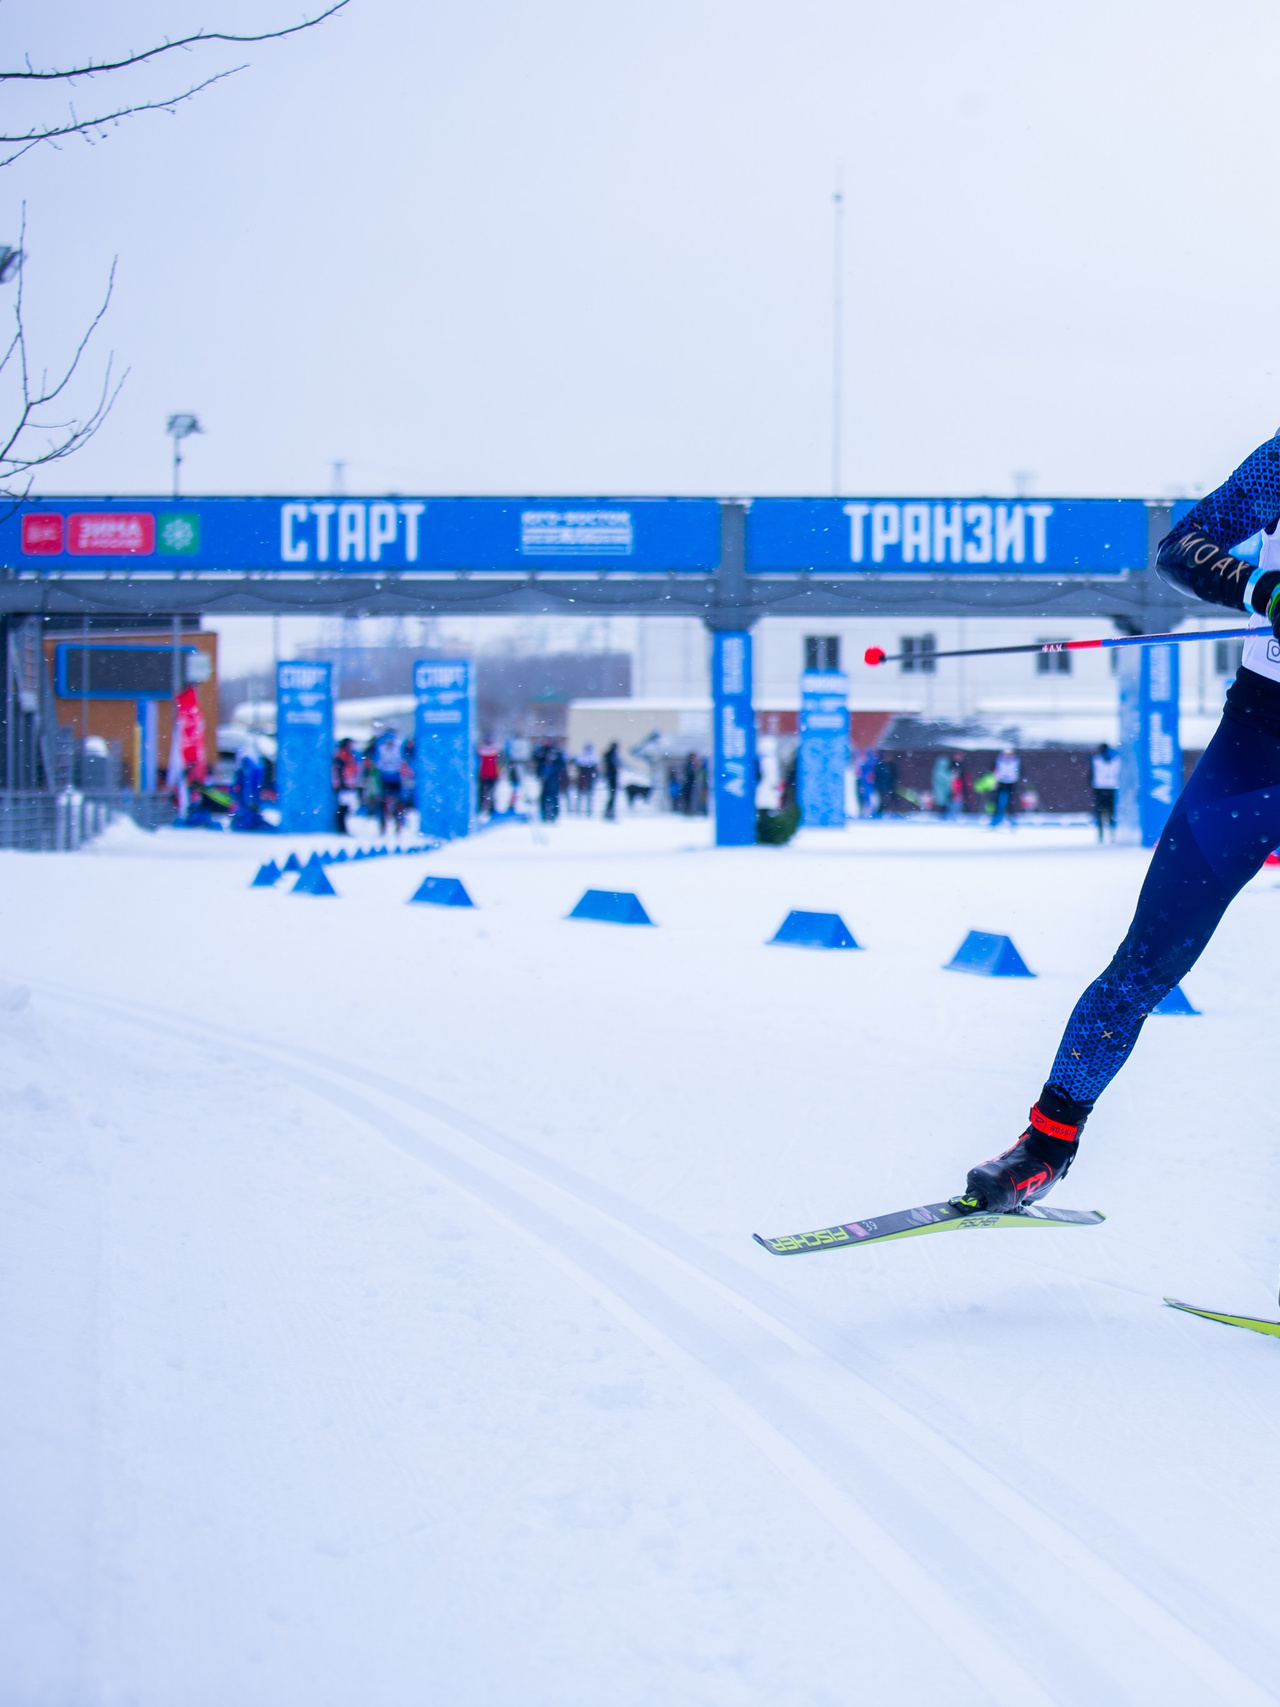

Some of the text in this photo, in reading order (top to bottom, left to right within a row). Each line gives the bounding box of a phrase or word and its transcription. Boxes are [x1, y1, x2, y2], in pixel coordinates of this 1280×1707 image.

[280, 503, 426, 562] СТАРТ
[842, 504, 1054, 563] ТРАНЗИТ
[1177, 531, 1251, 584] MOAX
[768, 1226, 850, 1252] FISCHER
[957, 1216, 999, 1229] FISCHER
